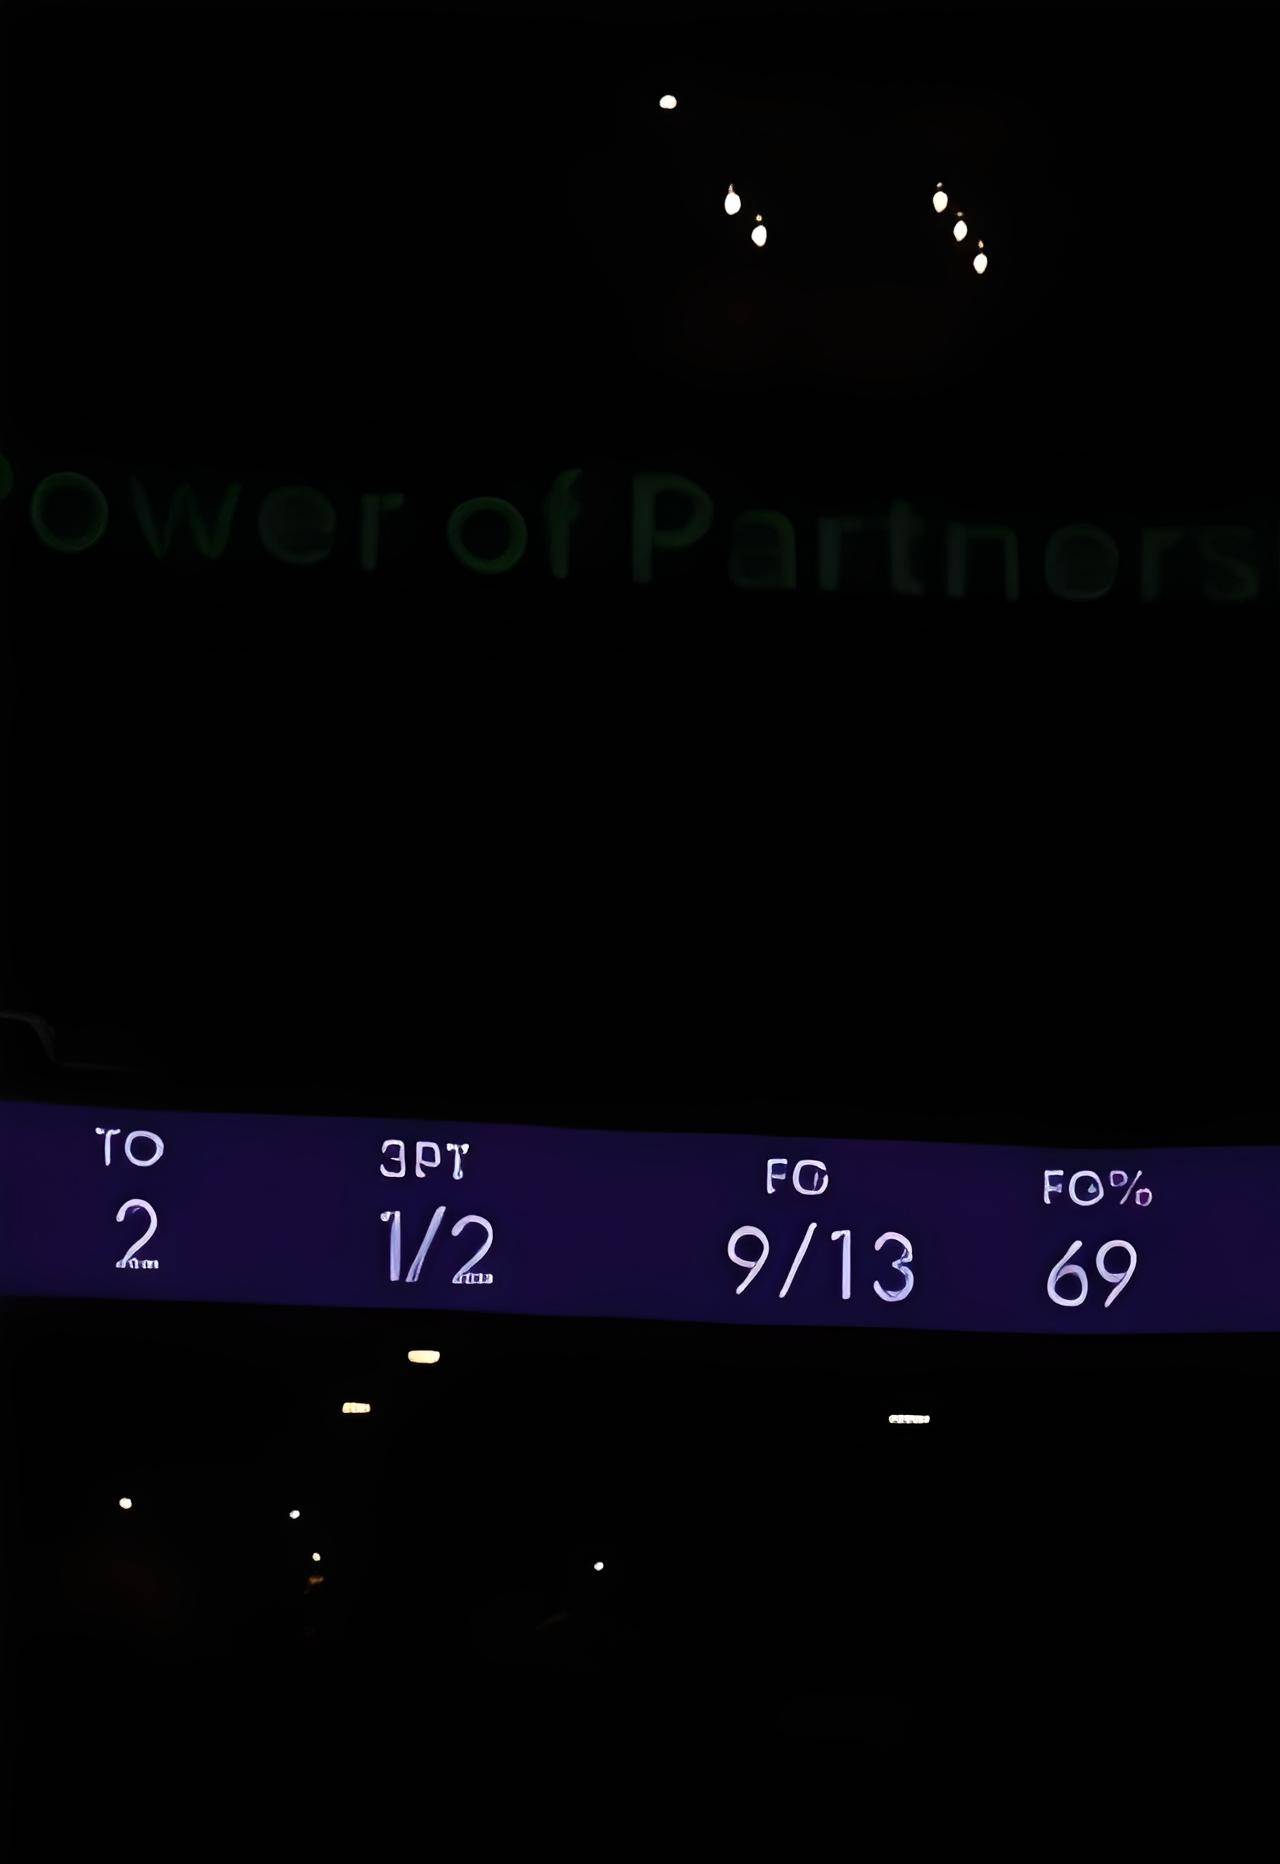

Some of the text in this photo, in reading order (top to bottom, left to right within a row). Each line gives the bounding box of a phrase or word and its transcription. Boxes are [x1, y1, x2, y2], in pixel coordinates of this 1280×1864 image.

[0, 453, 405, 573] ower
[446, 467, 584, 580] of
[94, 1127, 165, 1167] TO
[379, 1139, 470, 1181] 3PT
[115, 1198, 160, 1270] 2
[379, 1205, 494, 1285] 1/2
[727, 1222, 915, 1303] 9/13
[1046, 1239, 1138, 1308] 69
